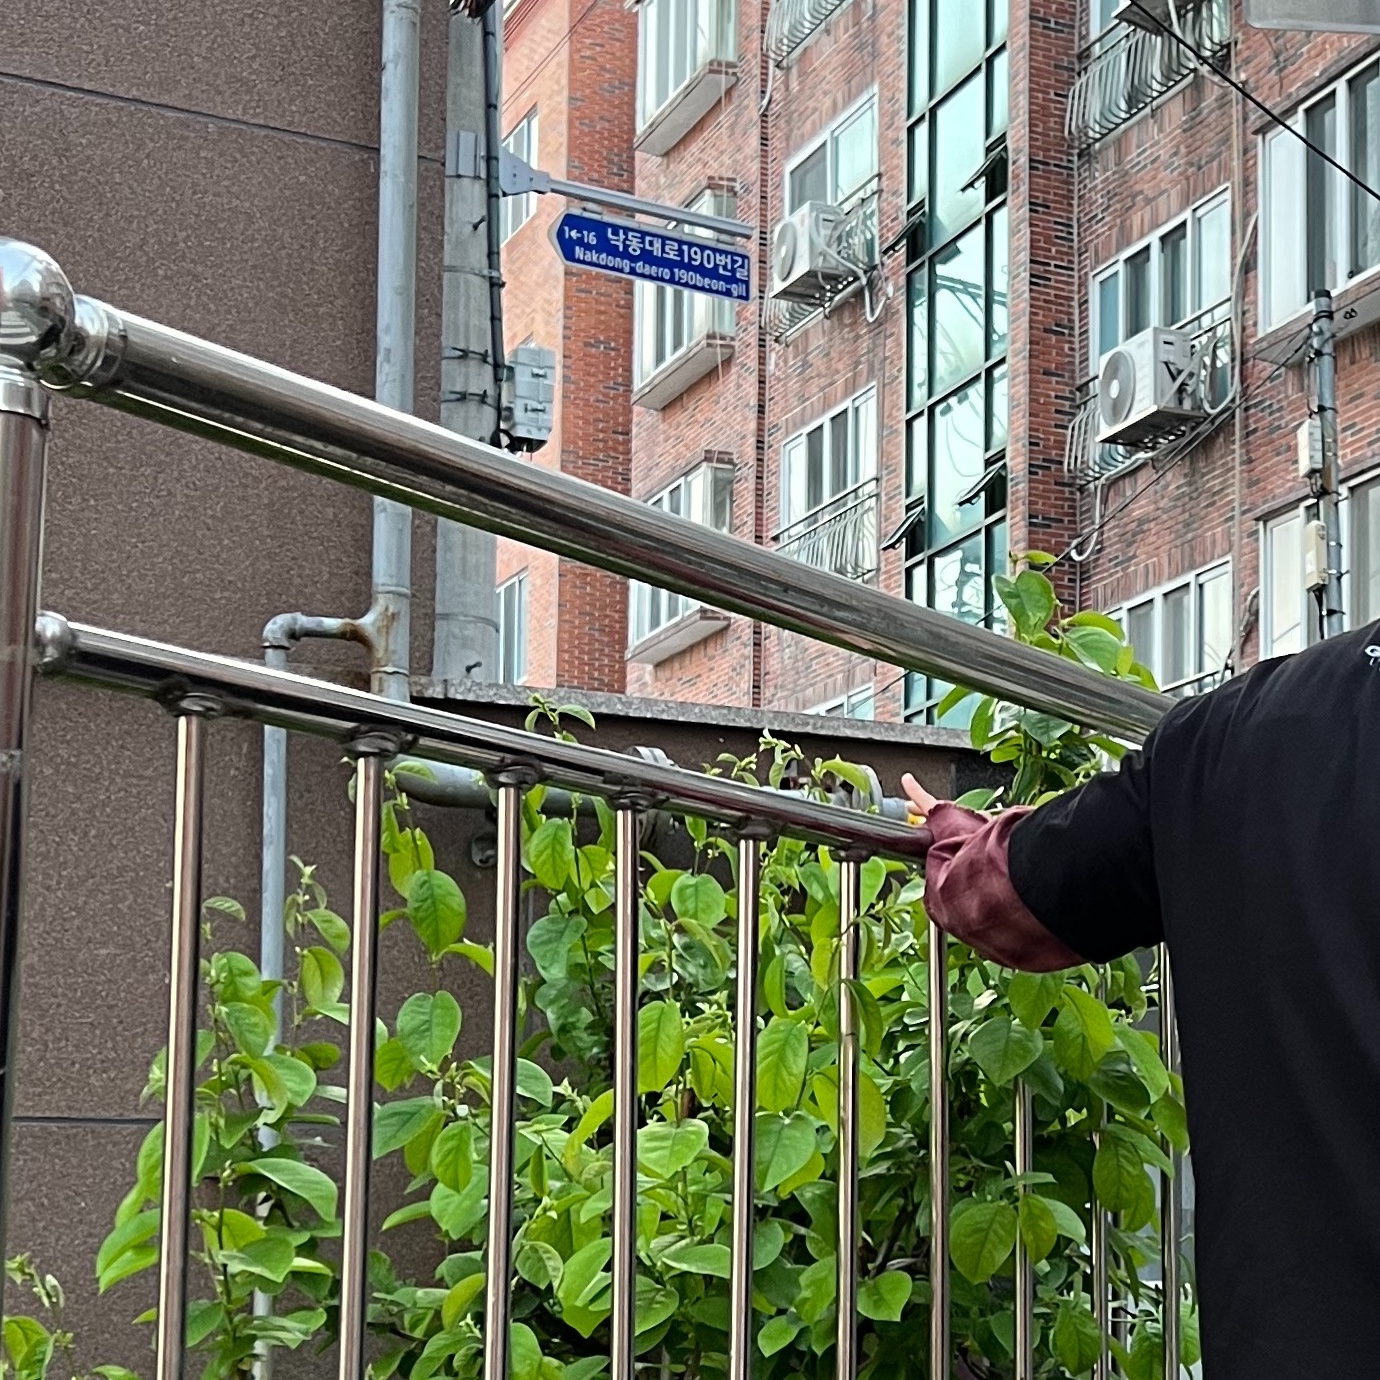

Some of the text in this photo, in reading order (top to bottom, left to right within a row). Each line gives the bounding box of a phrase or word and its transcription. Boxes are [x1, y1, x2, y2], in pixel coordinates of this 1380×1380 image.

[575, 246, 747, 297] Nakdong-daero 190beon-gil
[607, 227, 750, 281] 낙동대로190번길
